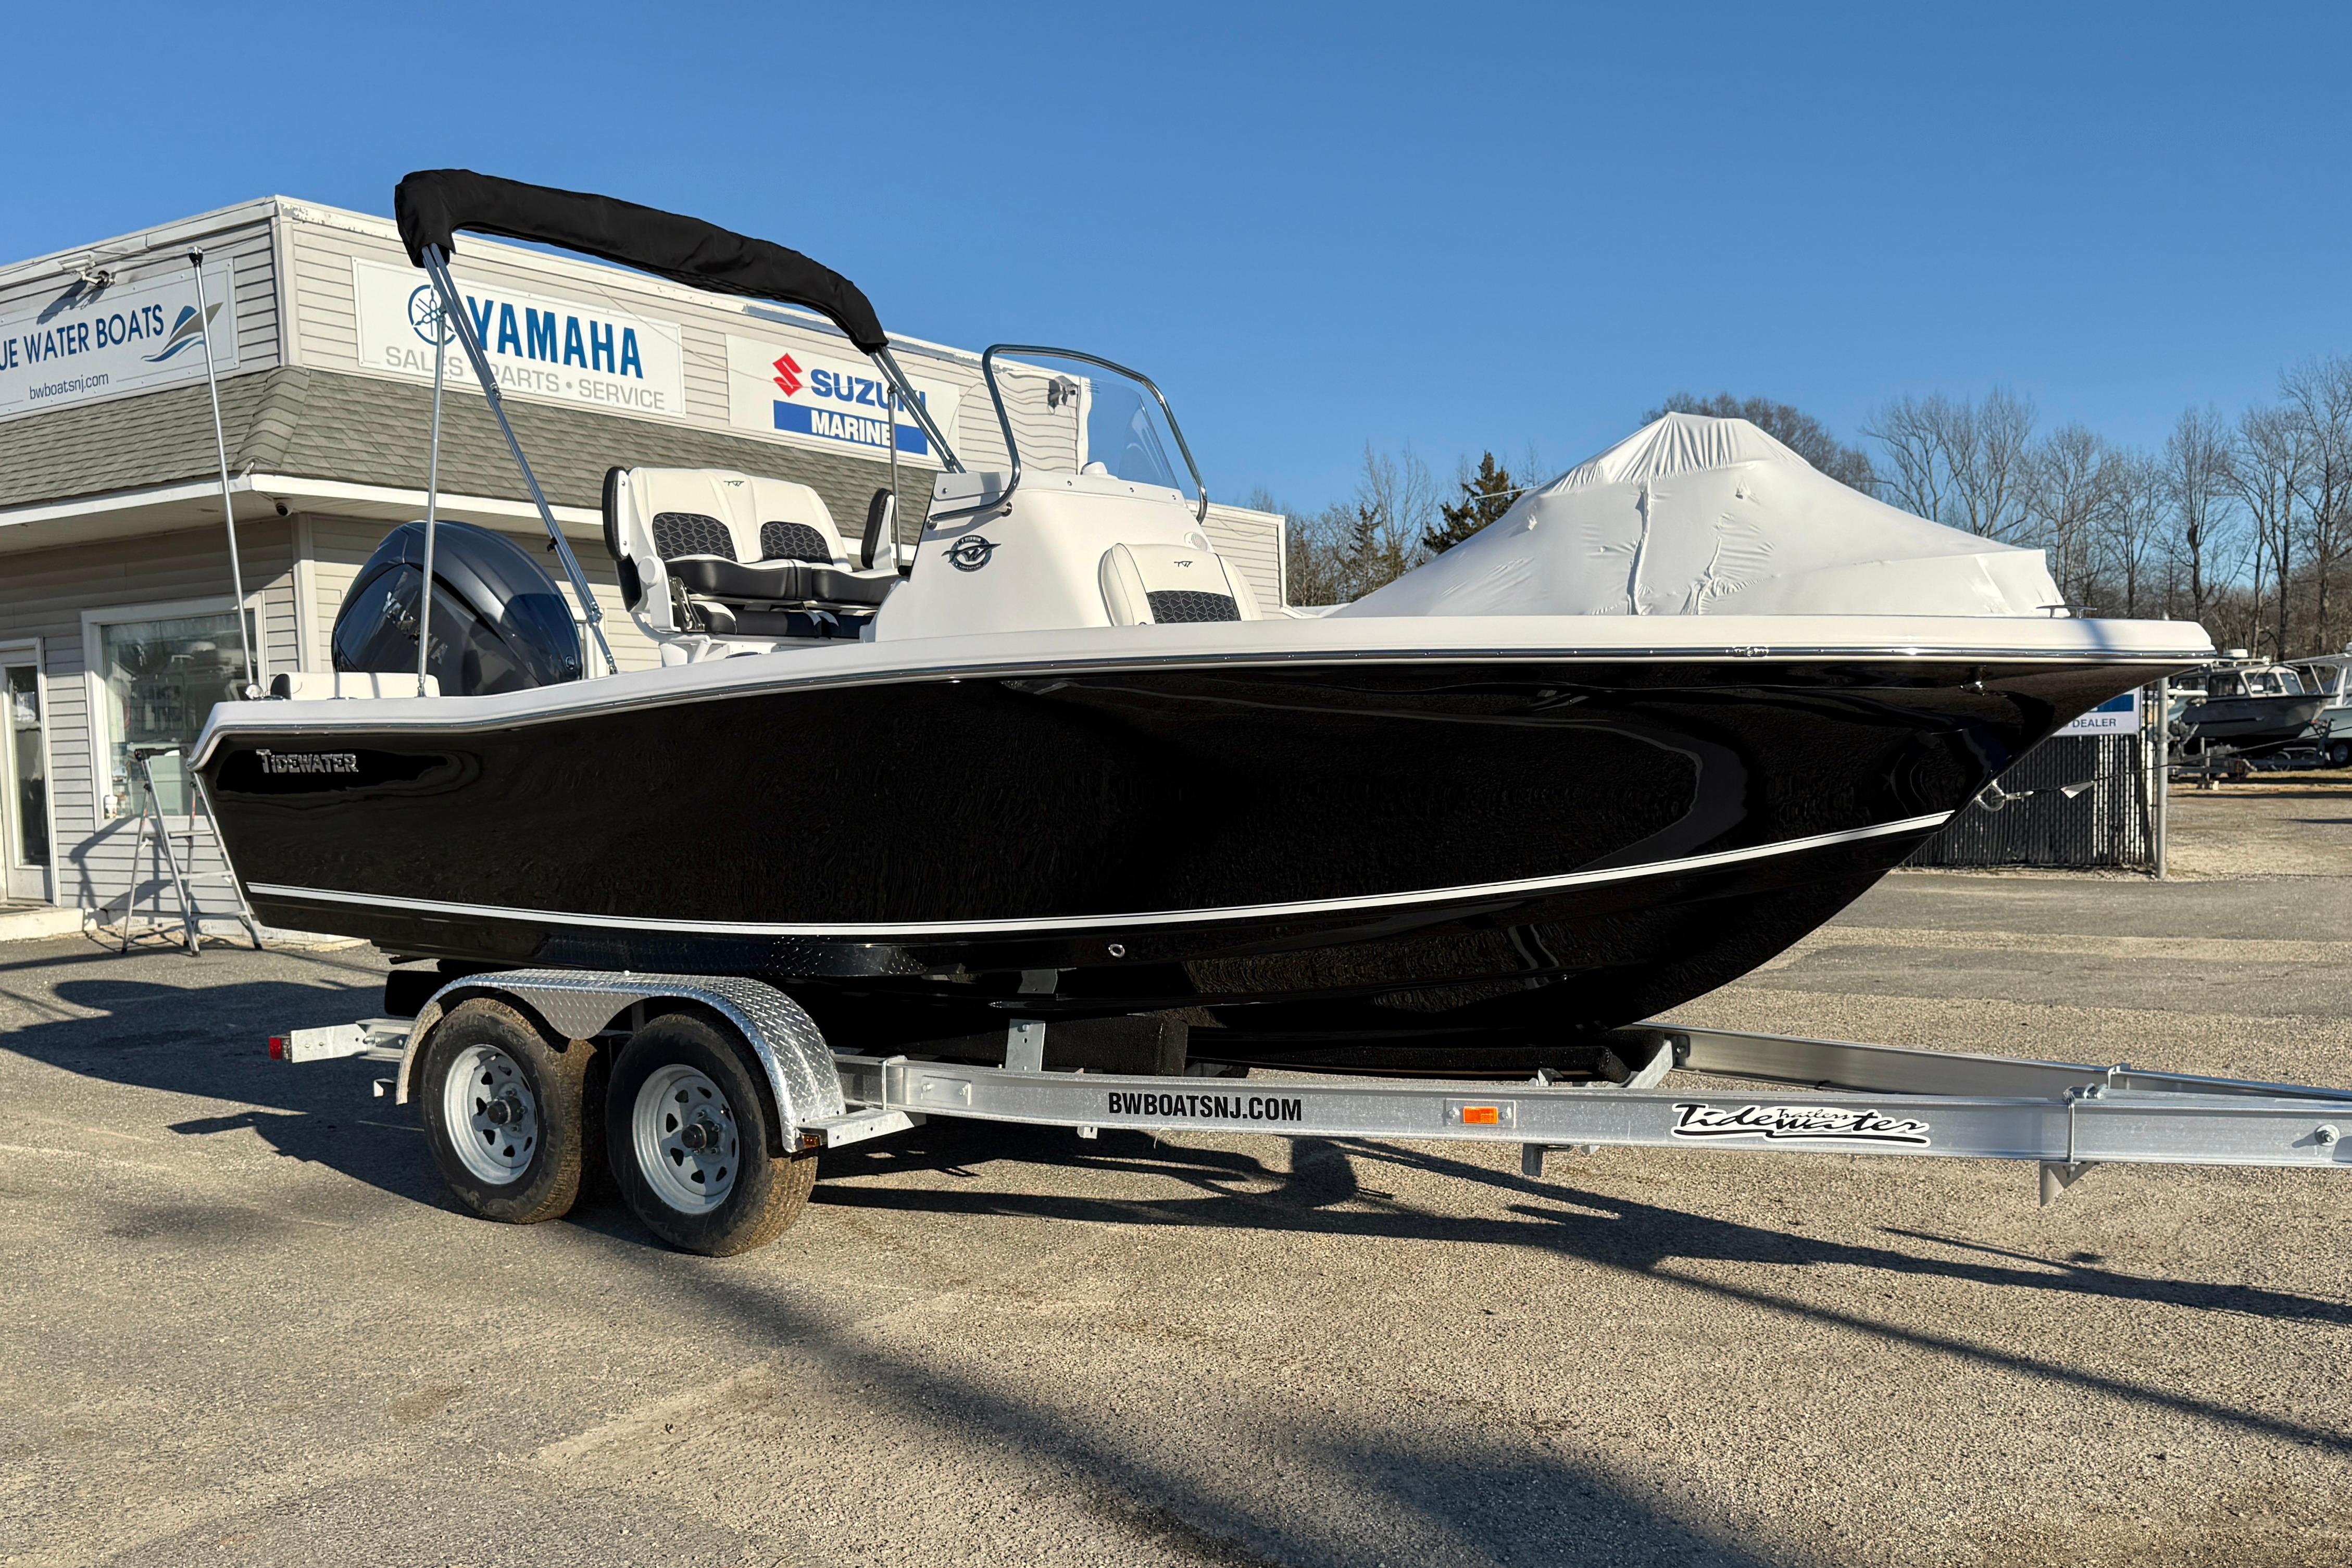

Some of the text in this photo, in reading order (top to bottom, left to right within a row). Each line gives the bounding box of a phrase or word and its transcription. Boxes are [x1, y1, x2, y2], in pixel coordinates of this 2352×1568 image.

[23, 322, 90, 365] WATER
[96, 304, 164, 349] BOATS
[466, 295, 643, 379] YAMAHA
[30, 373, 109, 400] bwboatsnj.com
[385, 345, 464, 377] SALS
[579, 379, 665, 410] SERVICE
[810, 409, 891, 446] MARINE
[2072, 718, 2117, 727] DEALER
[1108, 1092, 1302, 1121] BWBOATSNJ.COM
[1675, 1103, 1925, 1132] Tidewater
[1776, 1108, 1849, 1120] Trailers
